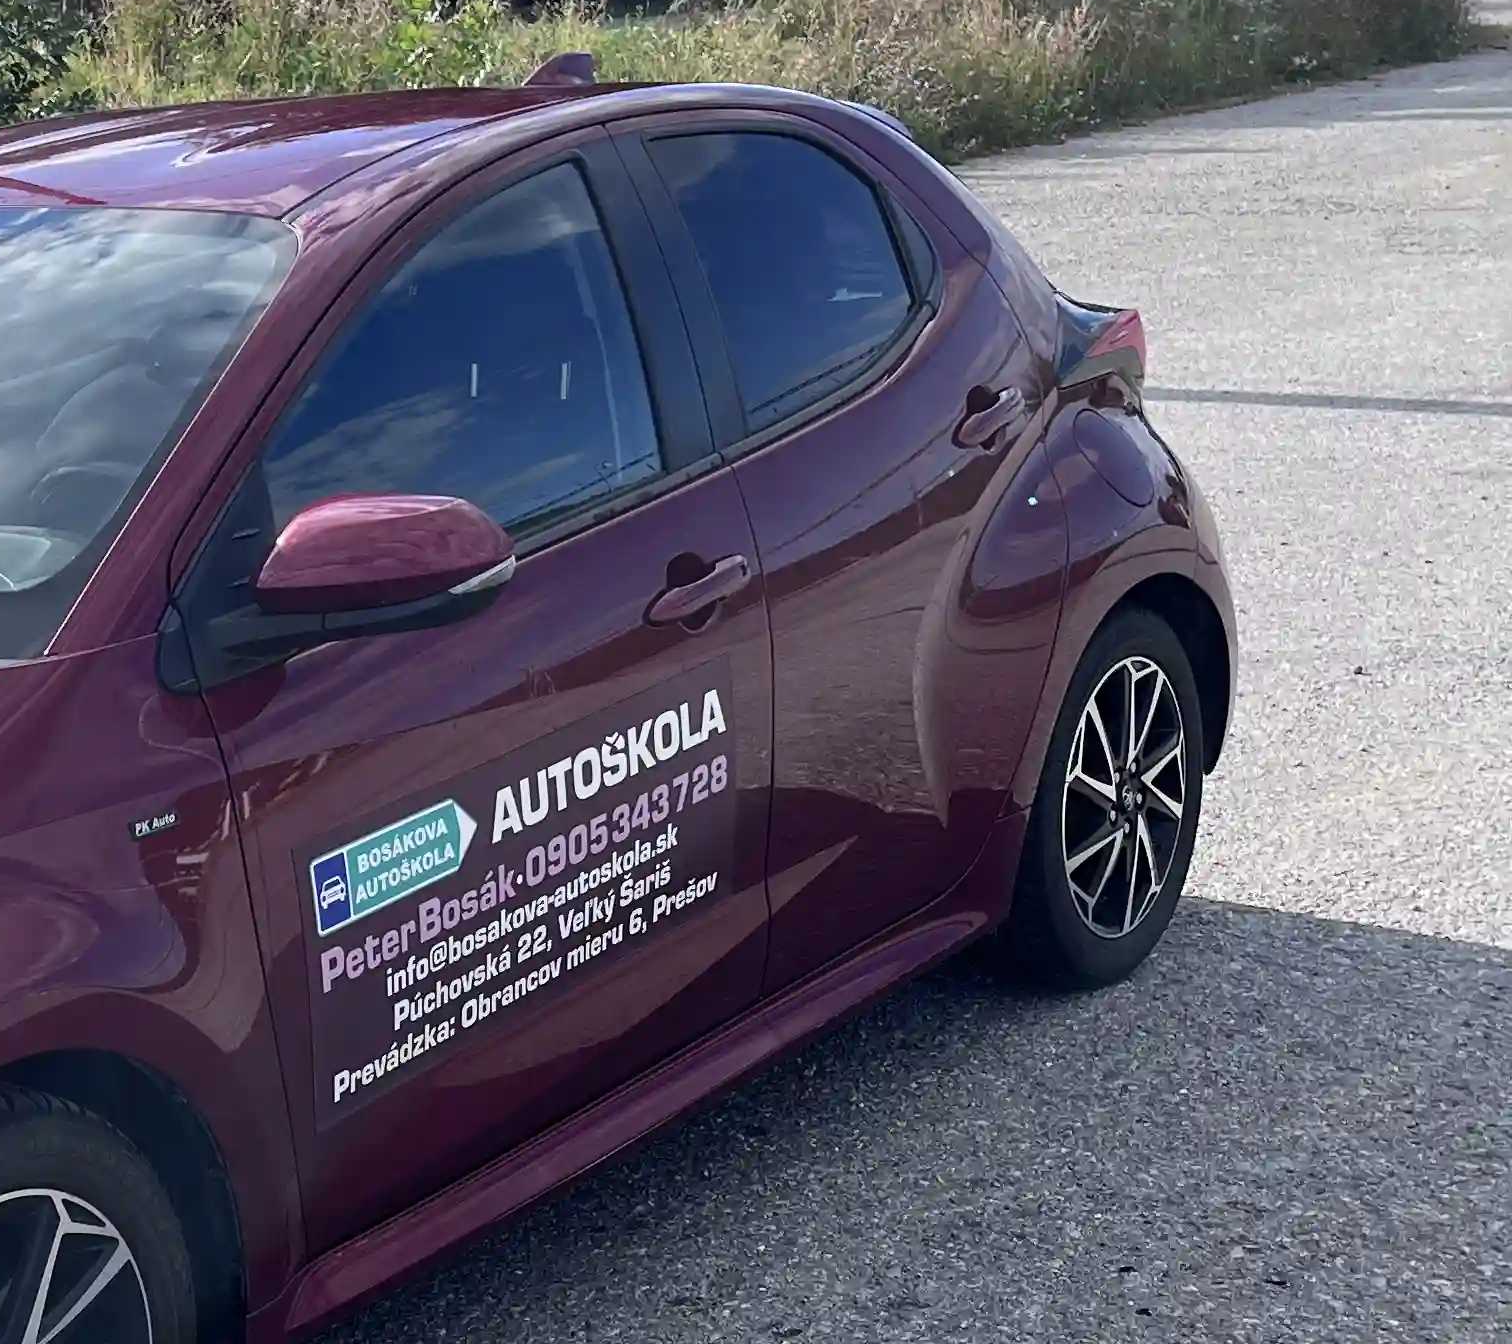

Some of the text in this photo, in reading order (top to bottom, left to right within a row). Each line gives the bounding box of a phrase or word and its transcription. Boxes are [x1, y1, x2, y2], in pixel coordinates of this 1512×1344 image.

[135, 813, 176, 835] PK Auto
[492, 688, 727, 844] AUTOŠKOLA
[355, 842, 455, 904] AUTOŠKOLA
[356, 818, 448, 873] BOSÁKOVA
[386, 823, 678, 997] info@bosakova-autoskola.sk
[334, 871, 718, 1103] Prevádzka: Obrancov mieru 6, Prešov
[394, 859, 671, 1031] Púchovská 22, Veľký Šariš
